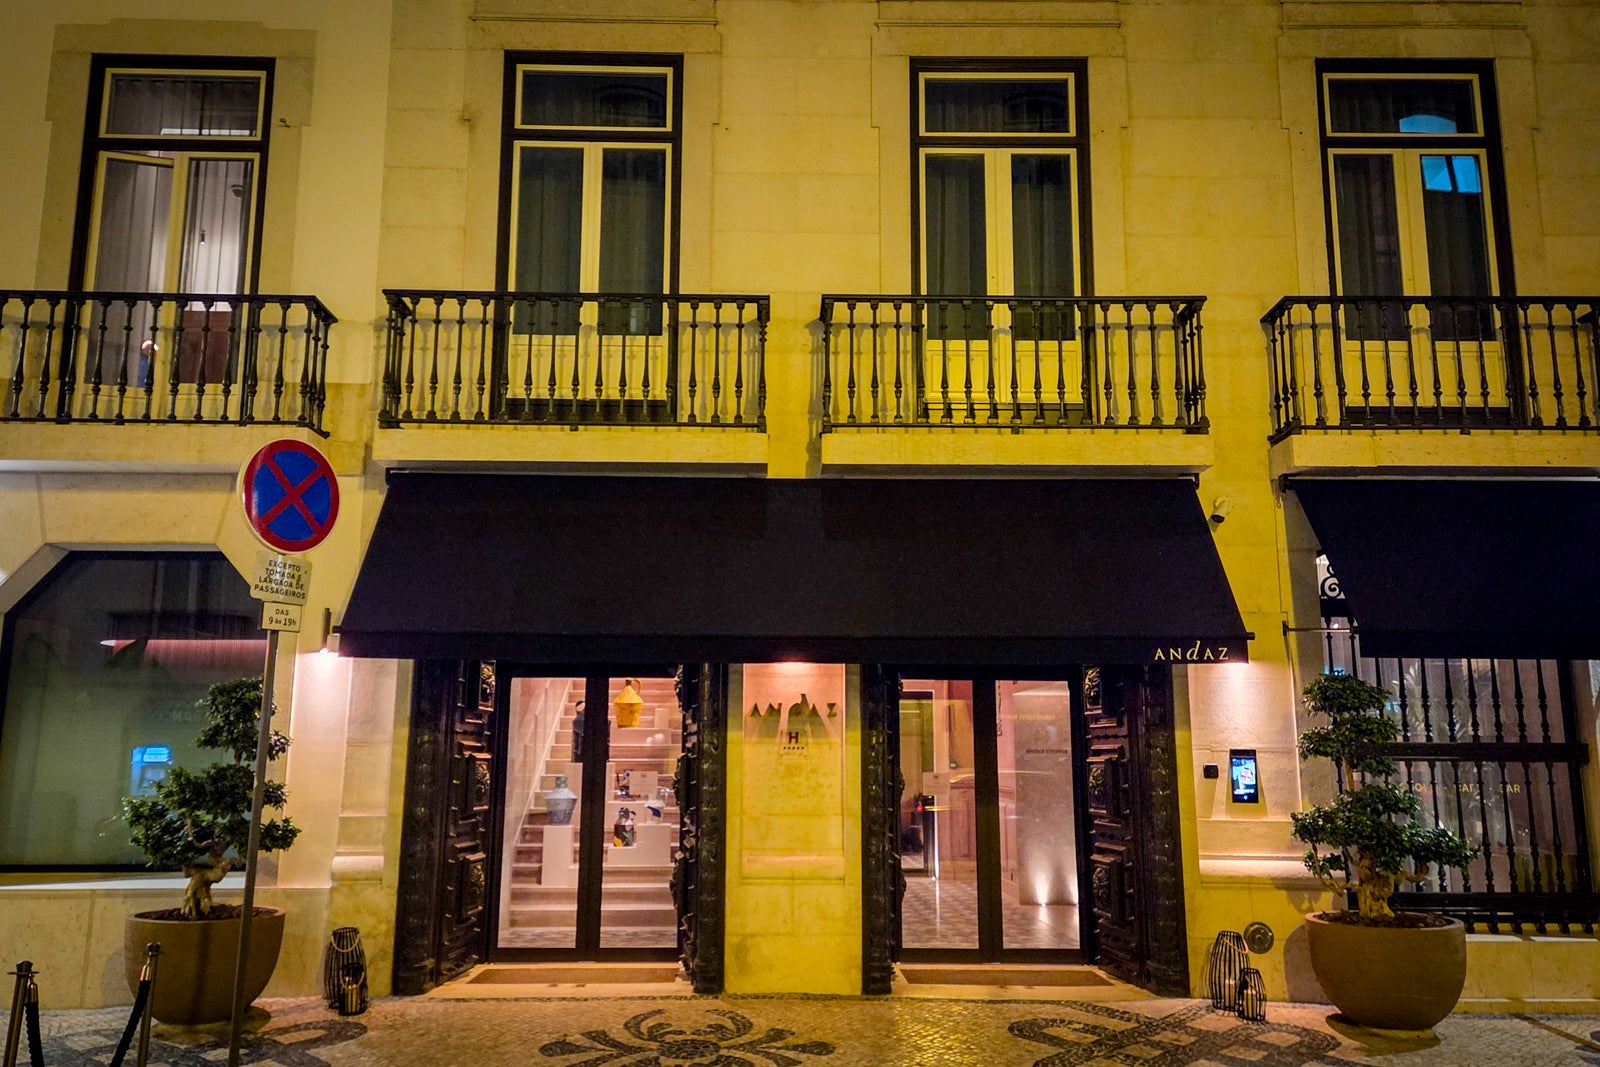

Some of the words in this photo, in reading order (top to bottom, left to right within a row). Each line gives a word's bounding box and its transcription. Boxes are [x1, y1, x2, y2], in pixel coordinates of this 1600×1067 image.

[268, 560, 301, 572] EXCEPTO
[265, 568, 295, 579] TOMADA
[258, 576, 293, 588] LARGADA
[295, 583, 304, 591] DE
[254, 584, 306, 599] PASSAGEIROS
[268, 617, 273, 625] 9
[283, 618, 296, 626] 19h
[788, 732, 799, 744] H
